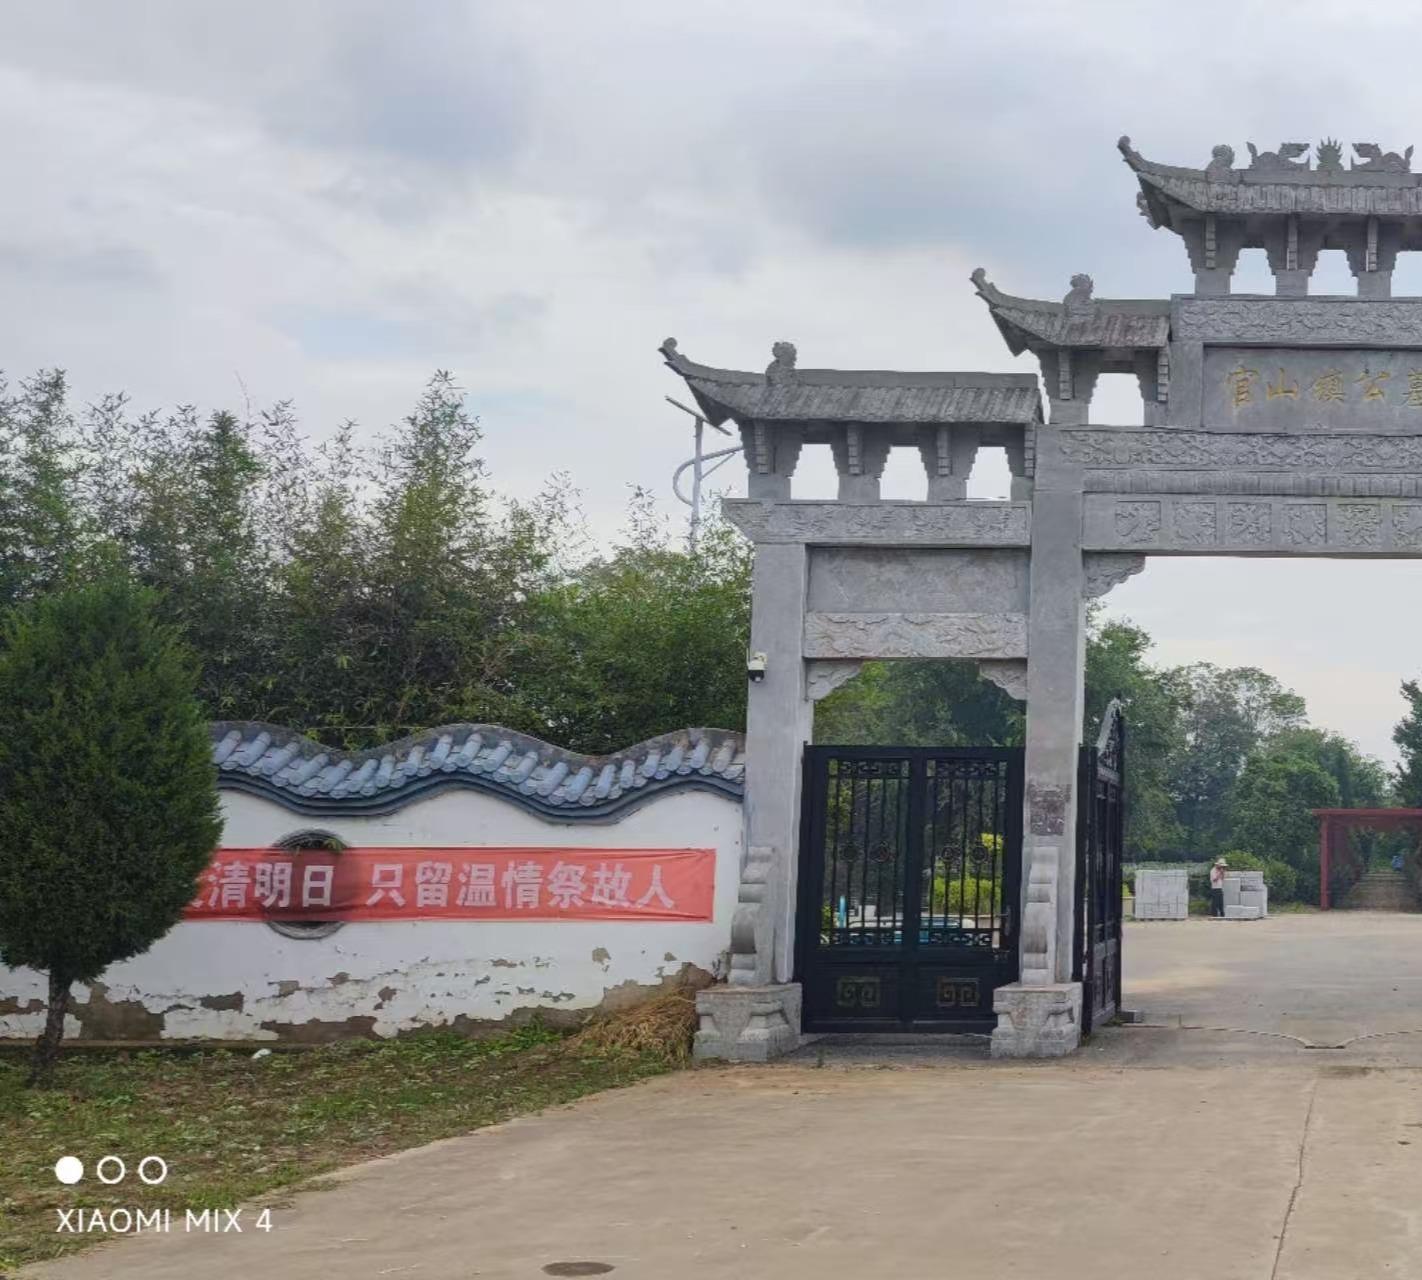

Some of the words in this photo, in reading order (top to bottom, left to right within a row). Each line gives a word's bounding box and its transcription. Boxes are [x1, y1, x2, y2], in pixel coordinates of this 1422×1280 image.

[190, 860, 336, 909] 清明日
[365, 860, 676, 909] 只留温情祭故人
